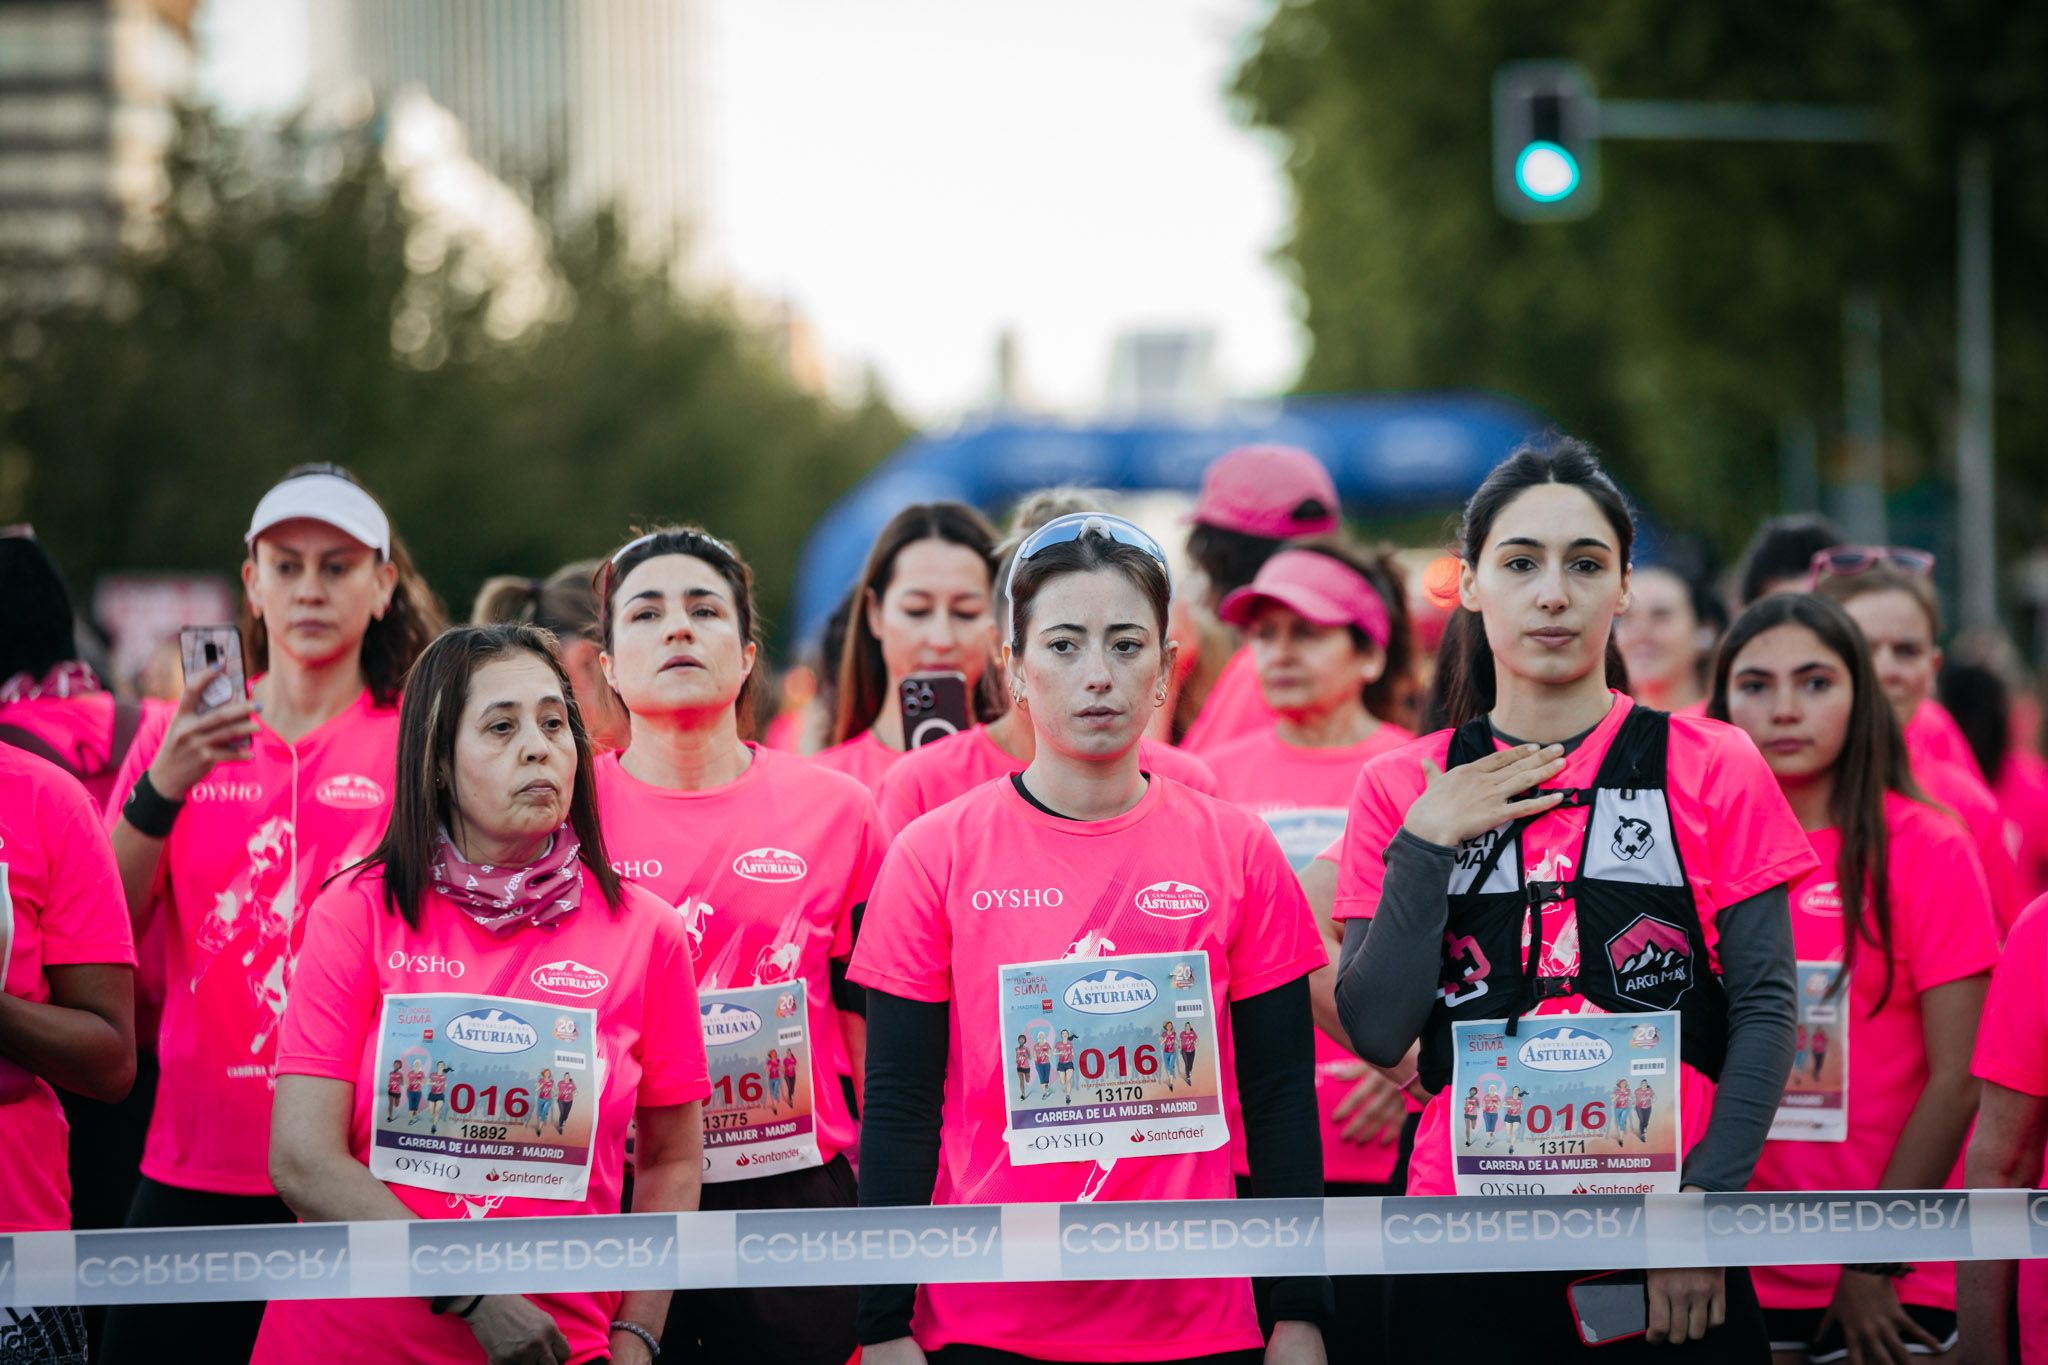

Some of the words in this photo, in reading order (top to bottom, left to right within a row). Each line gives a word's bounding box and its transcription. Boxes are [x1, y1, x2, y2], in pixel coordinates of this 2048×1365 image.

[611, 859, 663, 878] SHO
[740, 859, 802, 875] ASTURIANA
[972, 887, 1064, 911] OYSHO
[1142, 894, 1204, 910] ASTURIANA
[388, 950, 465, 978] OYSHO
[538, 972, 602, 990] ASTURIANA
[1014, 983, 1048, 996] SUMA
[1071, 988, 1152, 1006] ASTURIANA
[397, 1014, 432, 1024] SUMA
[704, 1020, 756, 1036] URIANA
[451, 1022, 532, 1045] ASTURIANA
[1469, 1040, 1504, 1052] SUMA
[1524, 1045, 1607, 1063] ASTURIANA
[1079, 1044, 1158, 1079] 016
[702, 1072, 762, 1107] 16
[1096, 1086, 1143, 1102] 13170
[450, 1083, 530, 1118] 016
[703, 1112, 748, 1129] 13775
[1035, 1112, 1083, 1123] CARRERA
[1086, 1108, 1100, 1119] DE
[1103, 1107, 1117, 1118] LA
[1120, 1104, 1153, 1117] MUJER
[1160, 1101, 1198, 1113] MADRID
[1526, 1101, 1607, 1134] 016
[461, 1124, 508, 1140] 18892
[710, 1134, 723, 1144] LA
[725, 1129, 758, 1143] MUJER
[765, 1122, 797, 1137] MADRID
[1035, 1131, 1104, 1151] OYSHO
[1147, 1127, 1205, 1142] Santander
[398, 1136, 446, 1151] CARRERA
[448, 1141, 462, 1153] DE
[464, 1142, 478, 1154] LA
[480, 1144, 514, 1157] MUJER
[522, 1147, 564, 1159] MADRID
[752, 1148, 800, 1165] Santander
[1539, 1140, 1585, 1155] 13171
[395, 1156, 461, 1180] OYSHO
[502, 1170, 564, 1185] Santander
[1479, 1159, 1526, 1170] CARRERA
[1528, 1160, 1542, 1170] DE
[1545, 1159, 1559, 1170] LA
[1562, 1158, 1598, 1170] MUJER
[1608, 1158, 1651, 1169] MADRID
[1480, 1182, 1545, 1195] OYSHO
[1590, 1182, 1655, 1195] Santander
